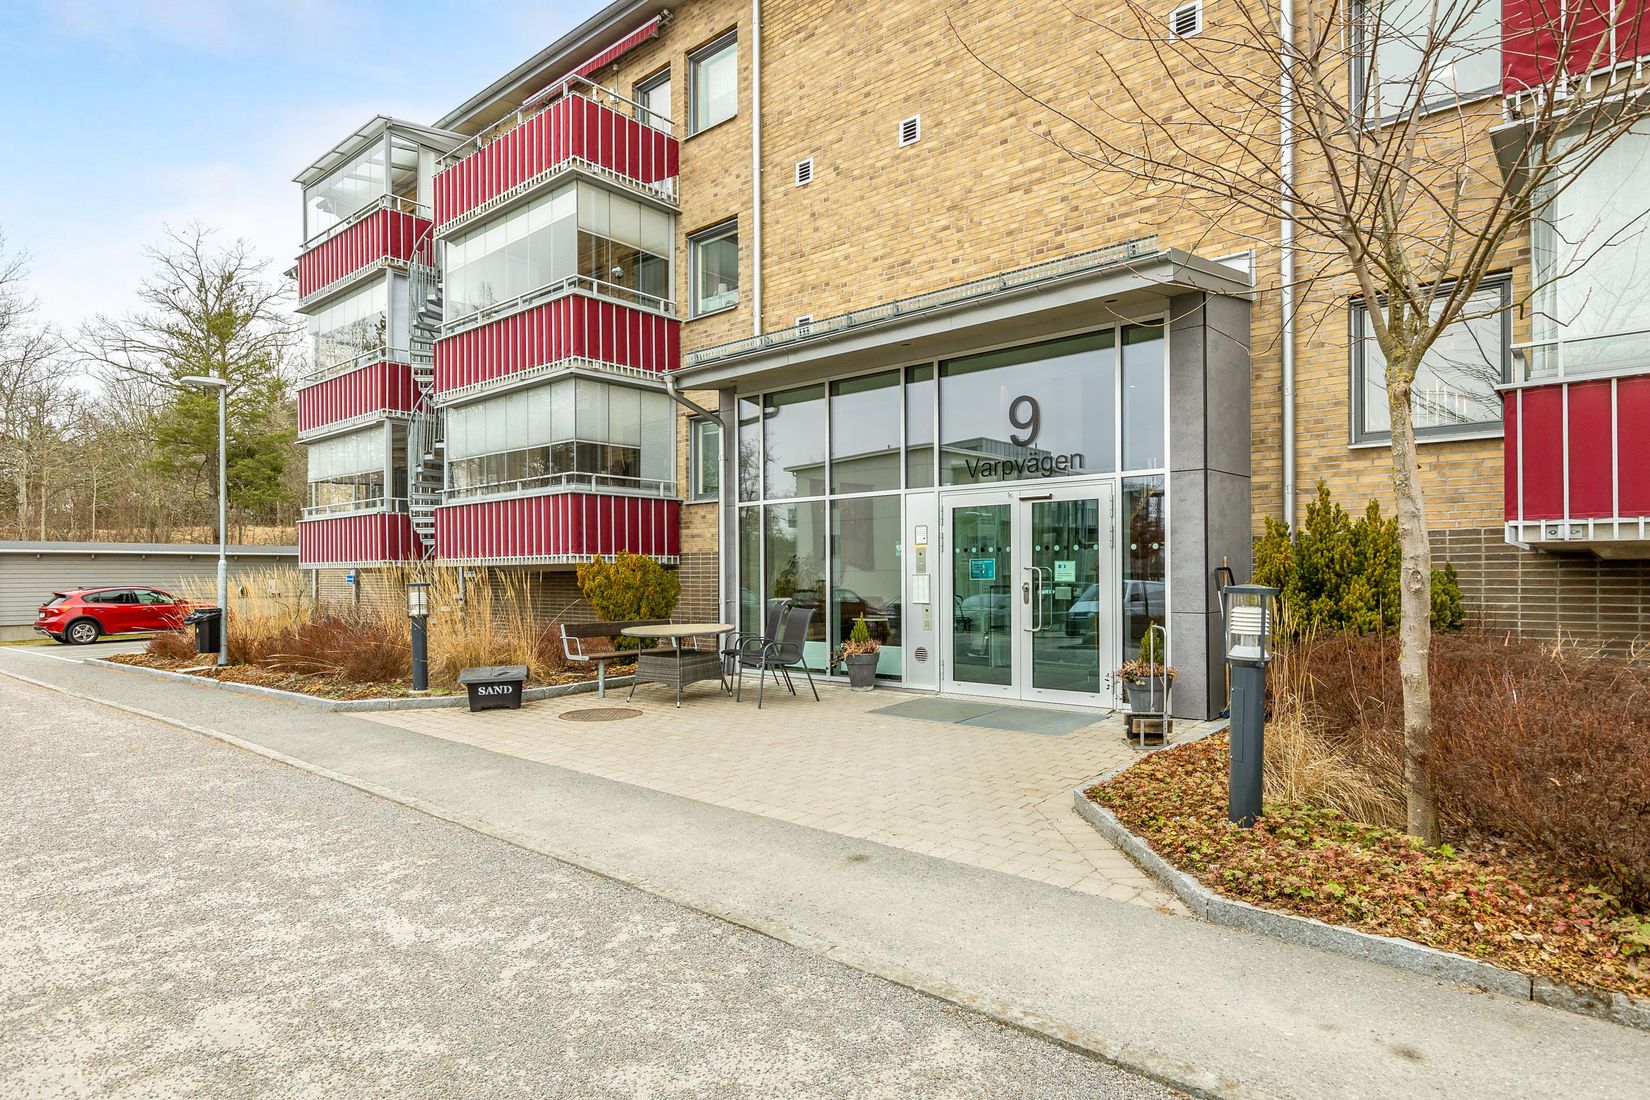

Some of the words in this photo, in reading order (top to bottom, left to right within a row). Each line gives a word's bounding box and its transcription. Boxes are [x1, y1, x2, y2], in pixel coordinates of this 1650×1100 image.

[1008, 394, 1041, 448] 9
[965, 451, 1085, 481] Varpvägen
[478, 685, 513, 696] SAND
